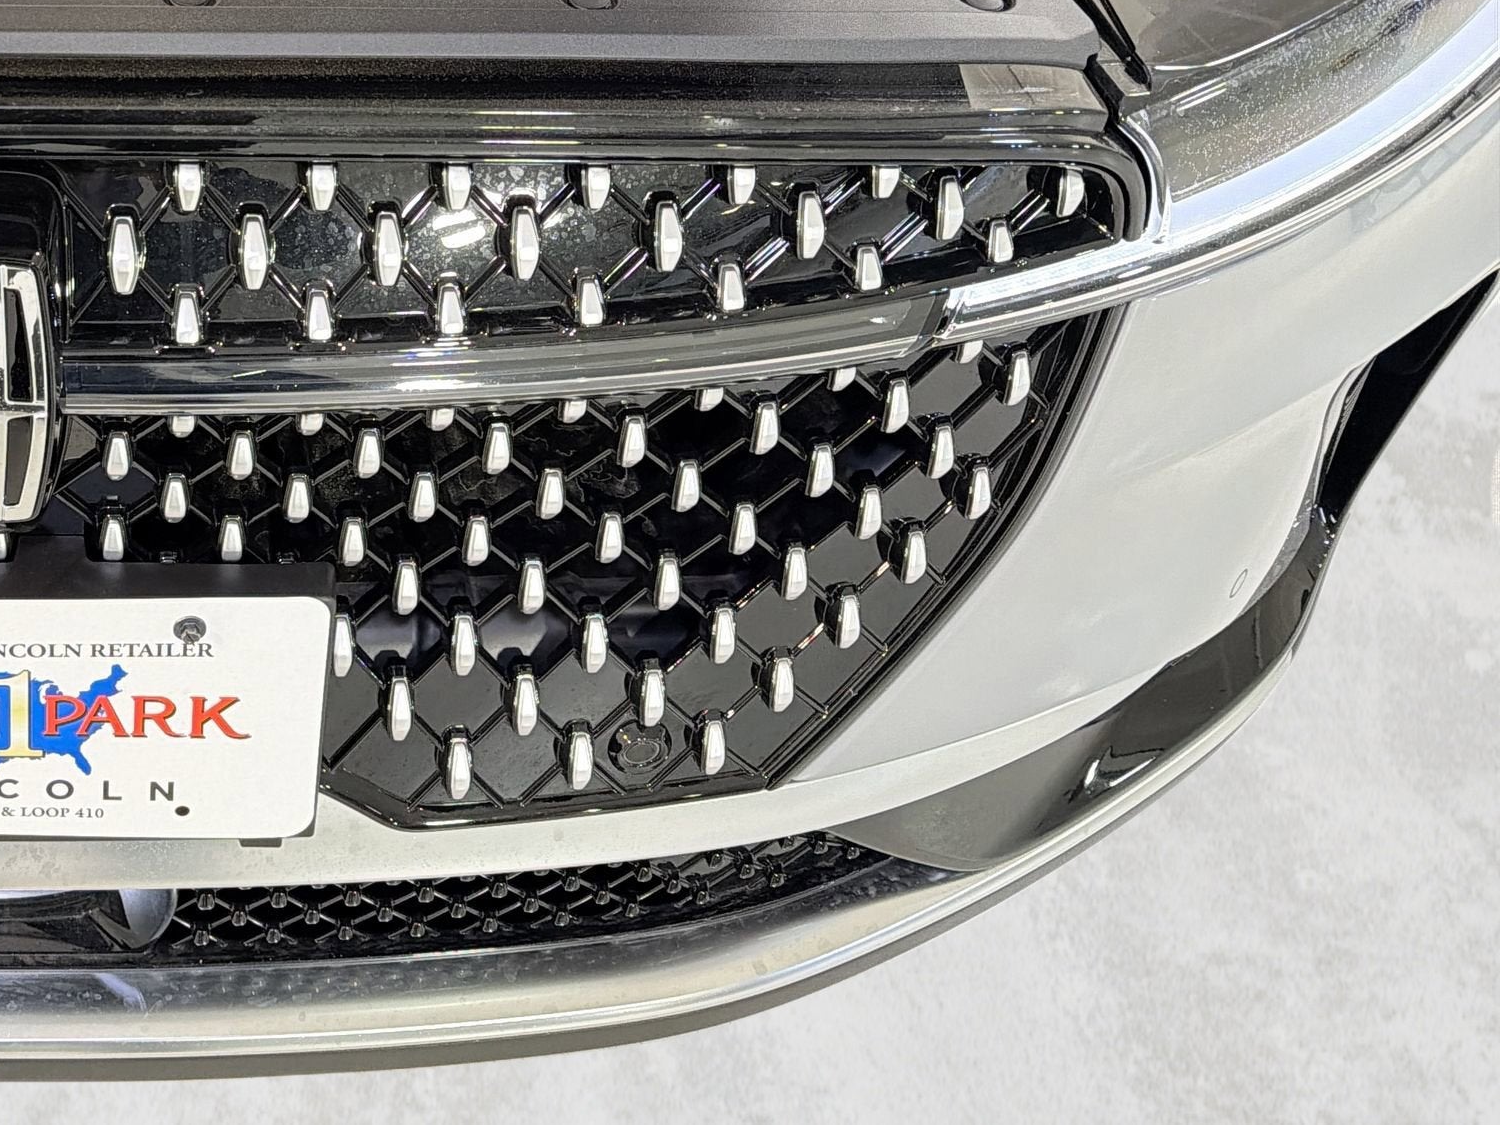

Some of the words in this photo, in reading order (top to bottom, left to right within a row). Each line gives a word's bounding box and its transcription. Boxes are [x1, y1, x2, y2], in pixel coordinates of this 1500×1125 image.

[89, 642, 215, 659] RETAILER
[42, 694, 253, 740] PARK
[1, 806, 17, 817] &
[20, 807, 71, 818] LOOP
[75, 807, 105, 818] 410
